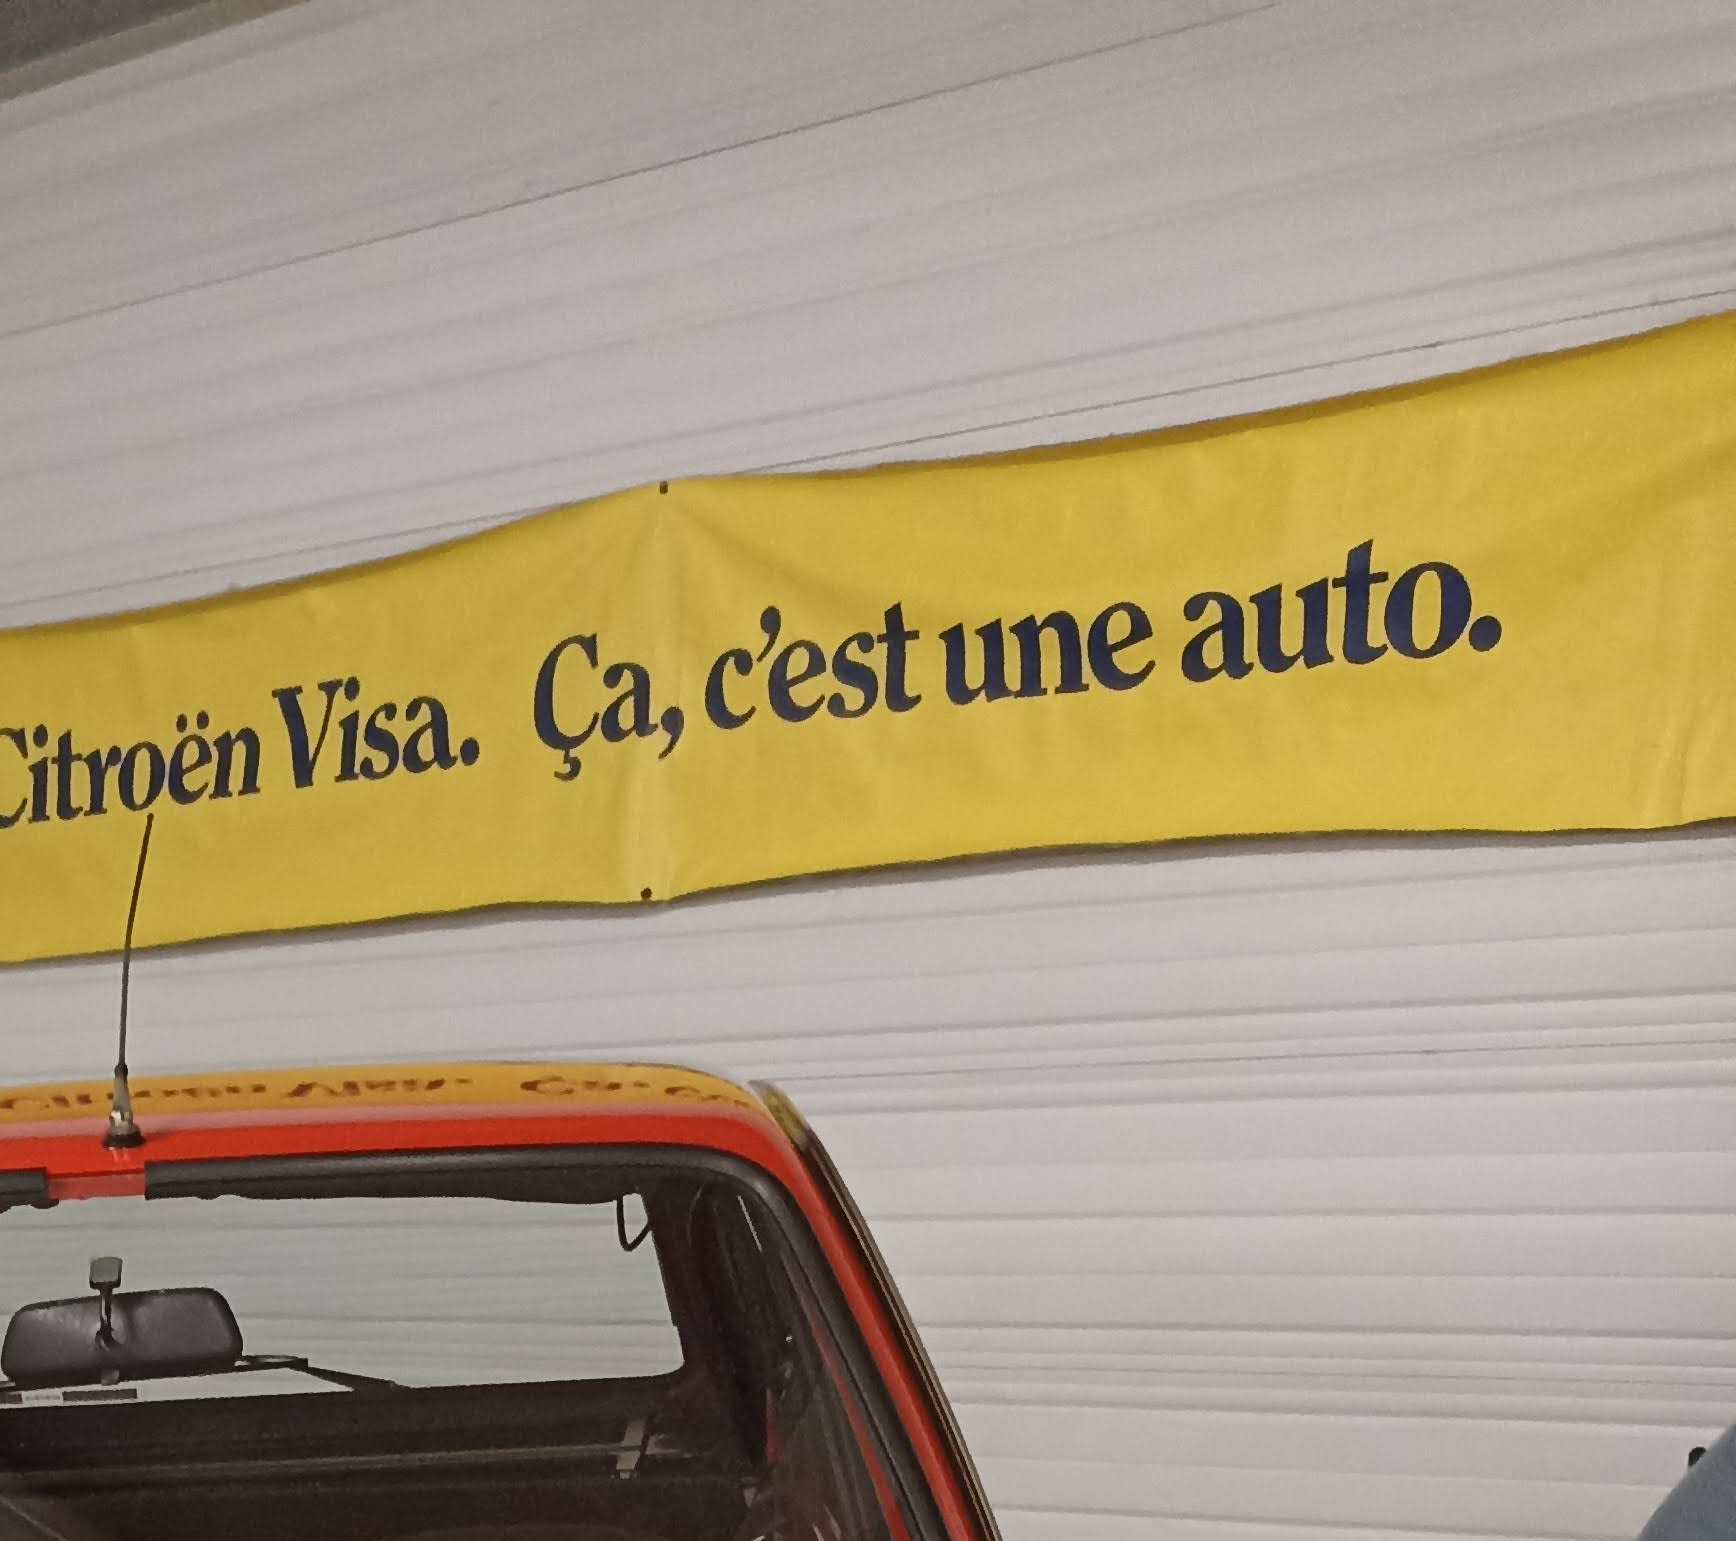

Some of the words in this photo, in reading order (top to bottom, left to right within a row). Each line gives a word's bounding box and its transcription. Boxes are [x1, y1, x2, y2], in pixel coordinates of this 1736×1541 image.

[270, 675, 481, 790] Visa.
[532, 632, 686, 782] Ça,
[703, 600, 923, 731] c'est
[937, 600, 1157, 707] une
[1180, 538, 1504, 684] auto.
